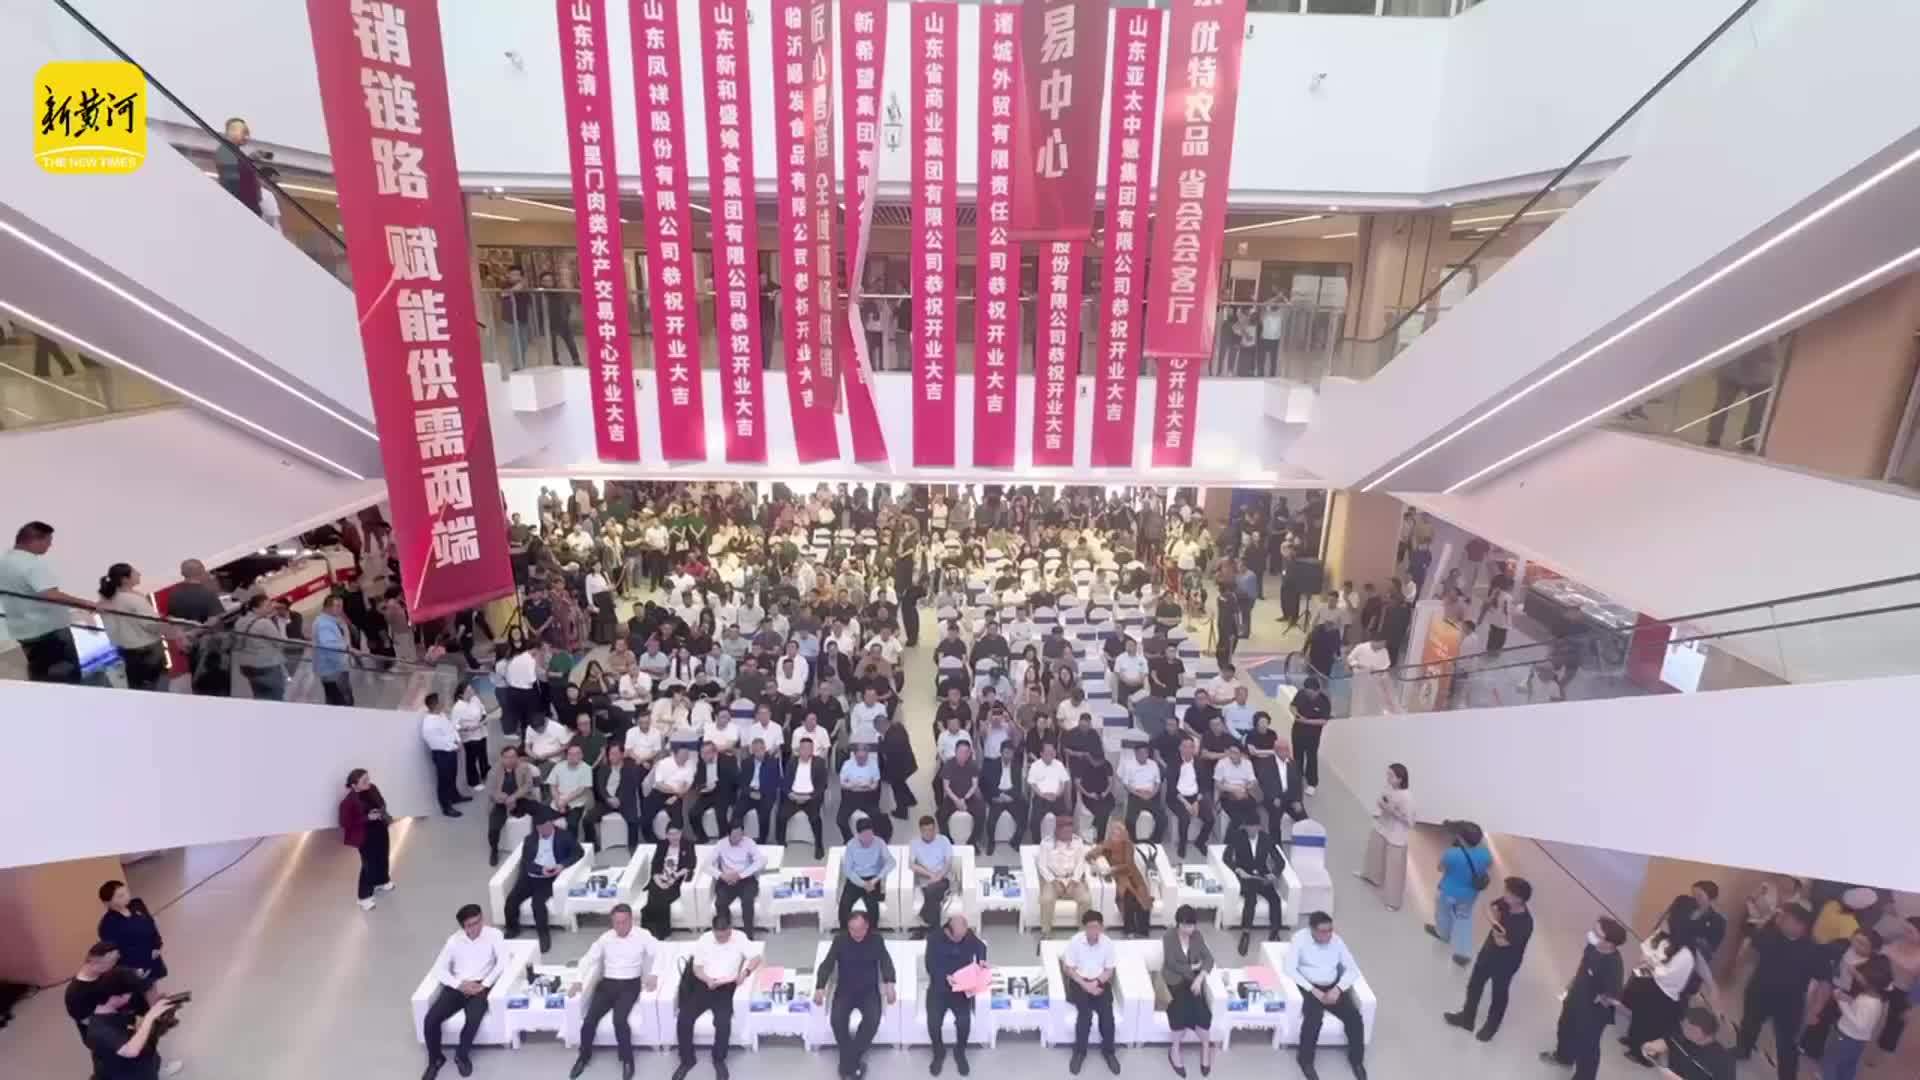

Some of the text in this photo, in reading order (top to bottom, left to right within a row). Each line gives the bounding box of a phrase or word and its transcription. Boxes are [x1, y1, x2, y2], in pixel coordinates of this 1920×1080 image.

[351, 0, 481, 569] 销链路 赋能供需两端
[643, 0, 689, 406] 山东凤祥股份有限公司恭祝开业大吉
[924, 12, 945, 401] 山东省商业集团有限公司恭祝开业大吉
[986, 12, 1014, 413] 诸城外贸有限责任公司恭祝开业大吉
[1166, 168, 1209, 325] 省会会客厅
